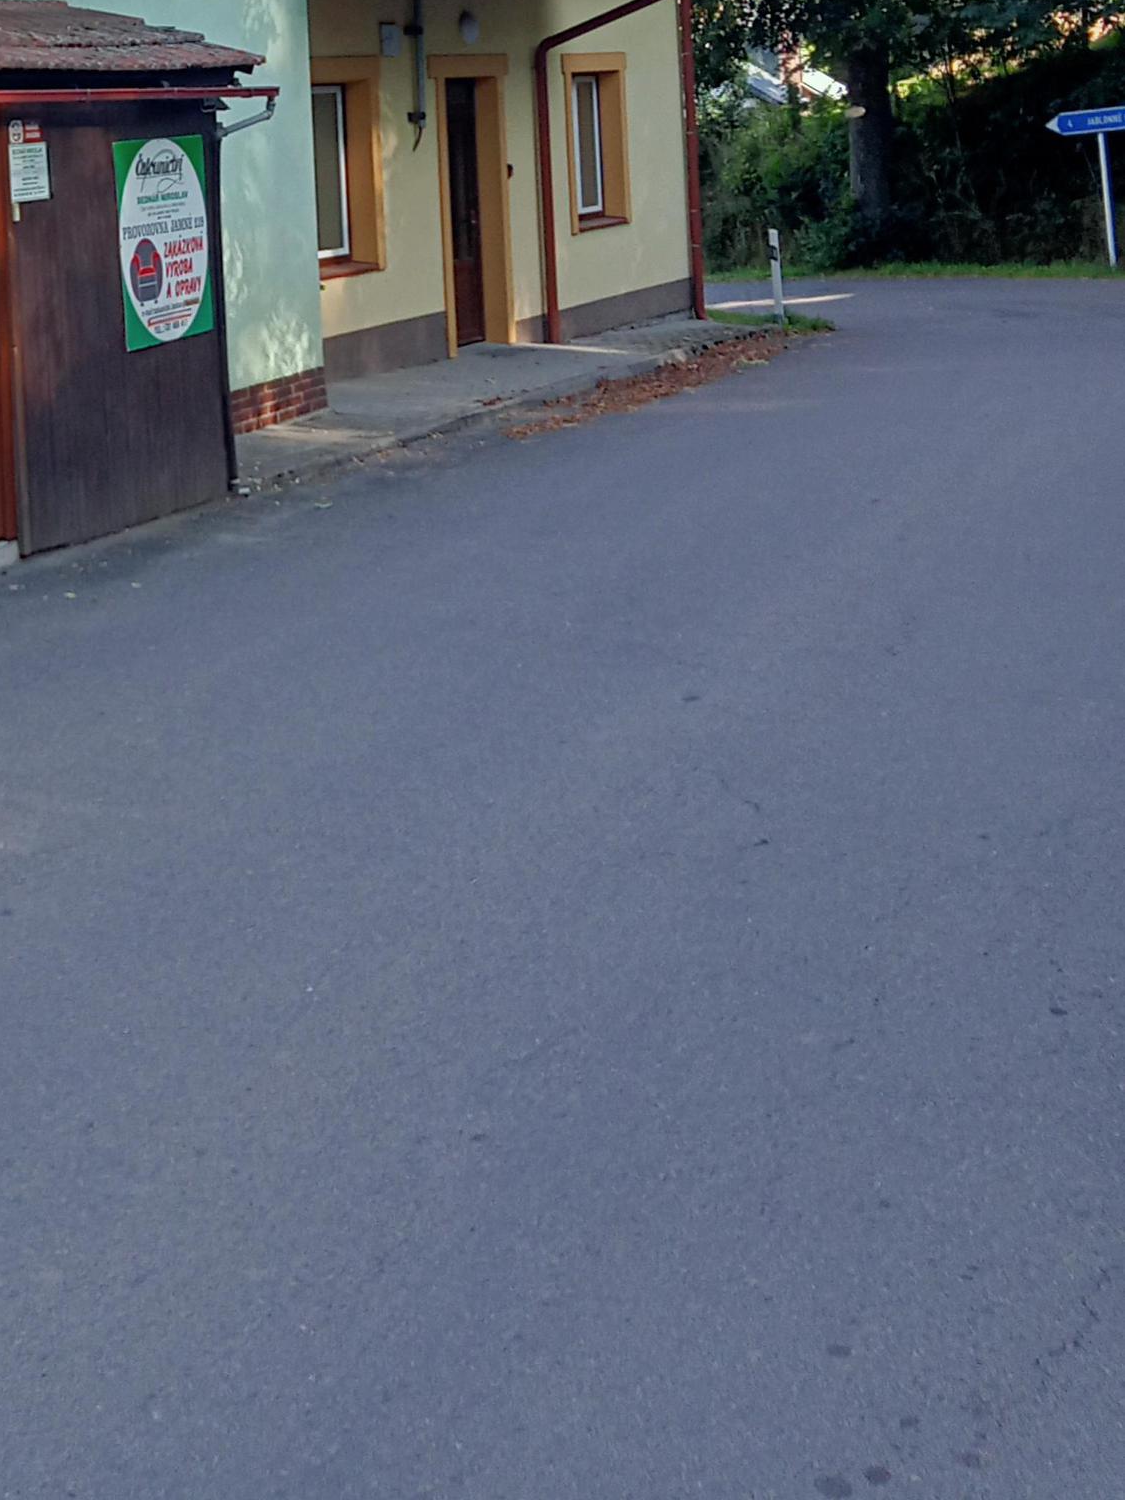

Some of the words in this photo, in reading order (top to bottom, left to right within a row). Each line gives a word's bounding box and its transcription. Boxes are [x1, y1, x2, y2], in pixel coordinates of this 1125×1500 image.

[163, 231, 204, 258] ZAKÁZKOVÁ
[166, 282, 172, 298] A
[175, 276, 202, 297] OPRAVY
